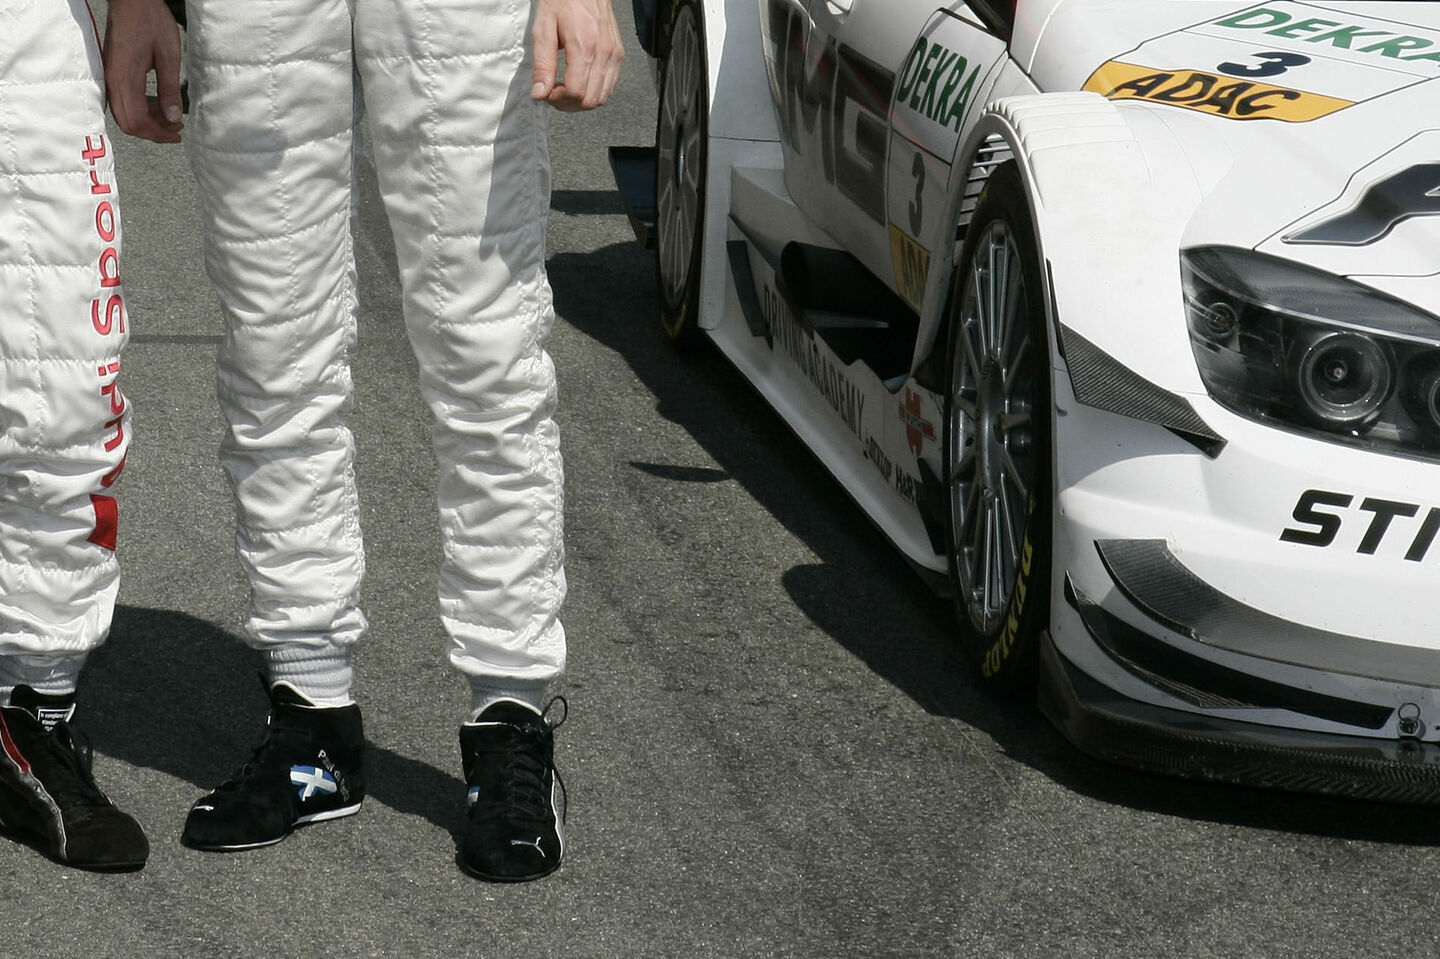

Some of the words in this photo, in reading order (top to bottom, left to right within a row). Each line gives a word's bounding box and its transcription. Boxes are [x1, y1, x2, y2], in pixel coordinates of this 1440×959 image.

[897, 36, 982, 134] DEKRA
[1112, 73, 1301, 117] ADAC
[1216, 52, 1312, 77] 3
[81, 134, 126, 336] Sport
[909, 152, 926, 239] 3
[1279, 488, 1440, 563] STI
